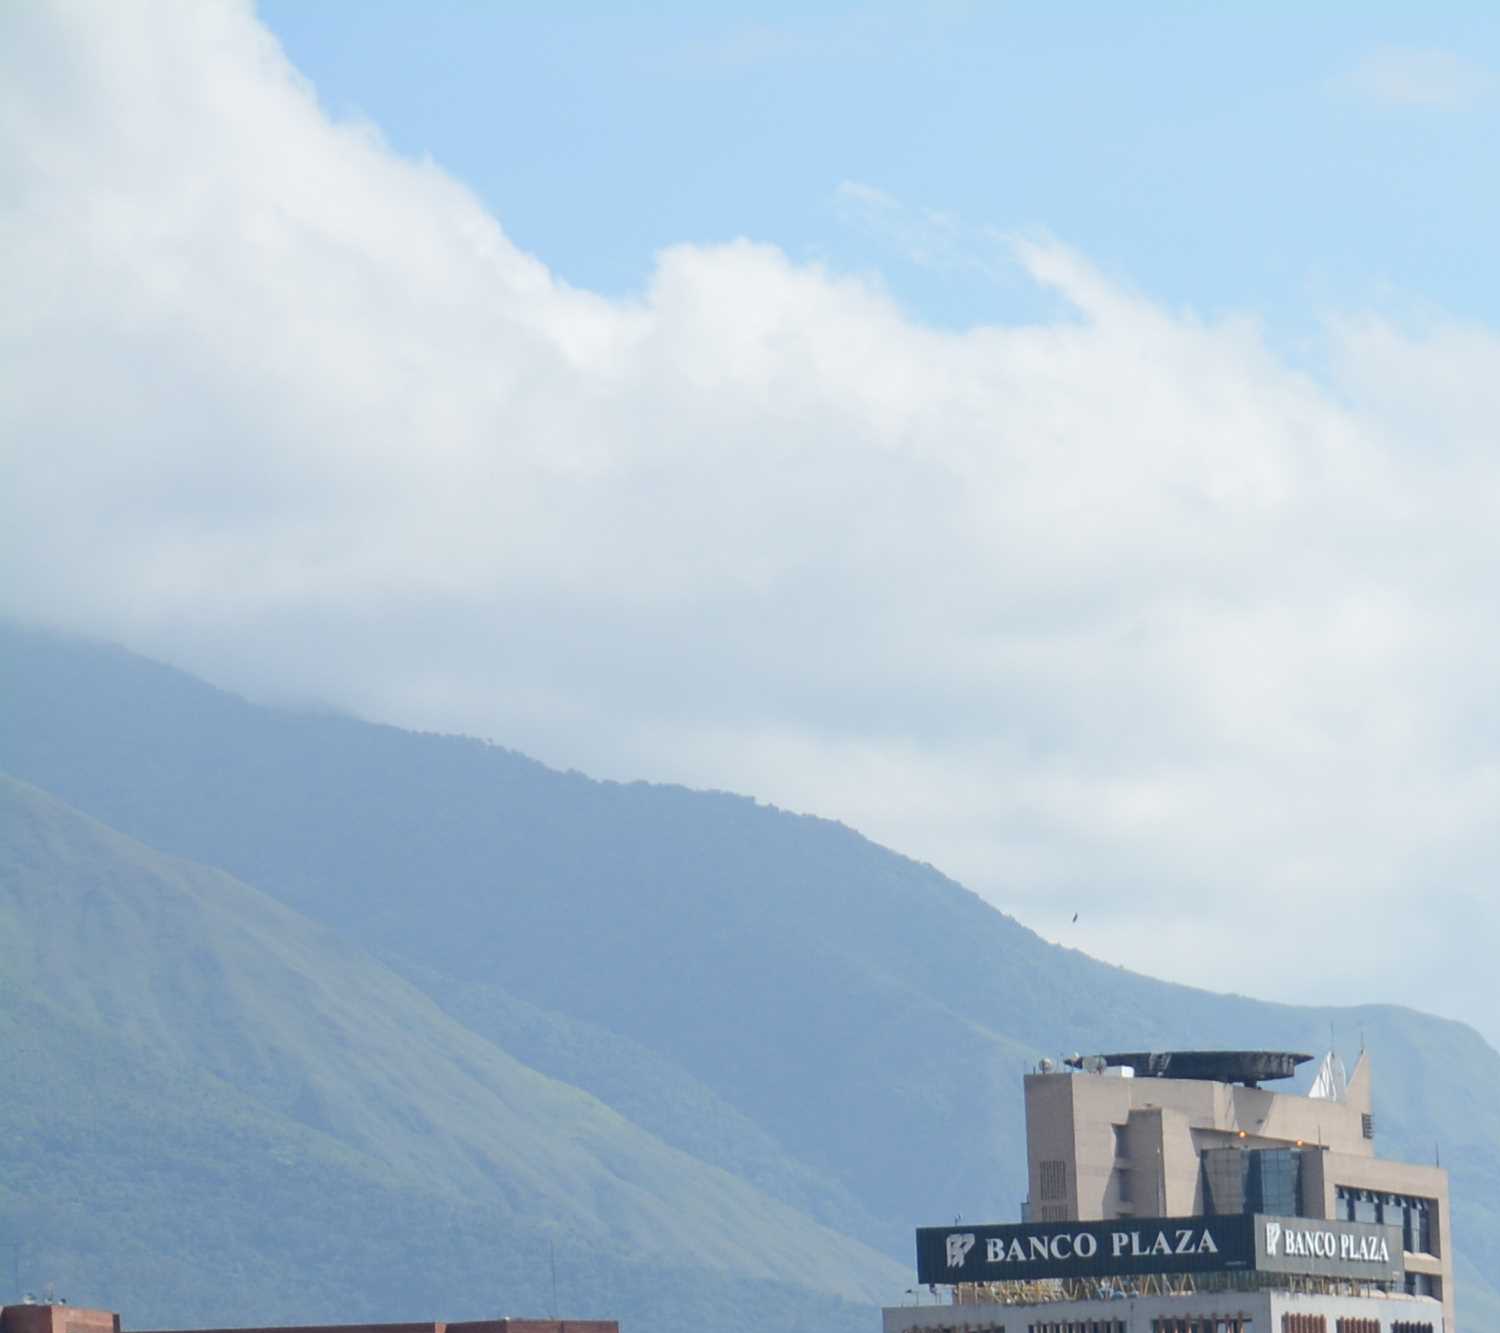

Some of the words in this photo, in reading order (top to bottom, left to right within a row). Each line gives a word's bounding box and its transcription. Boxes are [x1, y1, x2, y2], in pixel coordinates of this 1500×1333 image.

[985, 1232, 1097, 1262] BANCO
[1112, 1229, 1218, 1256] PLAZA
[1284, 1228, 1337, 1257] BANCO
[1340, 1233, 1389, 1262] PLAZA
